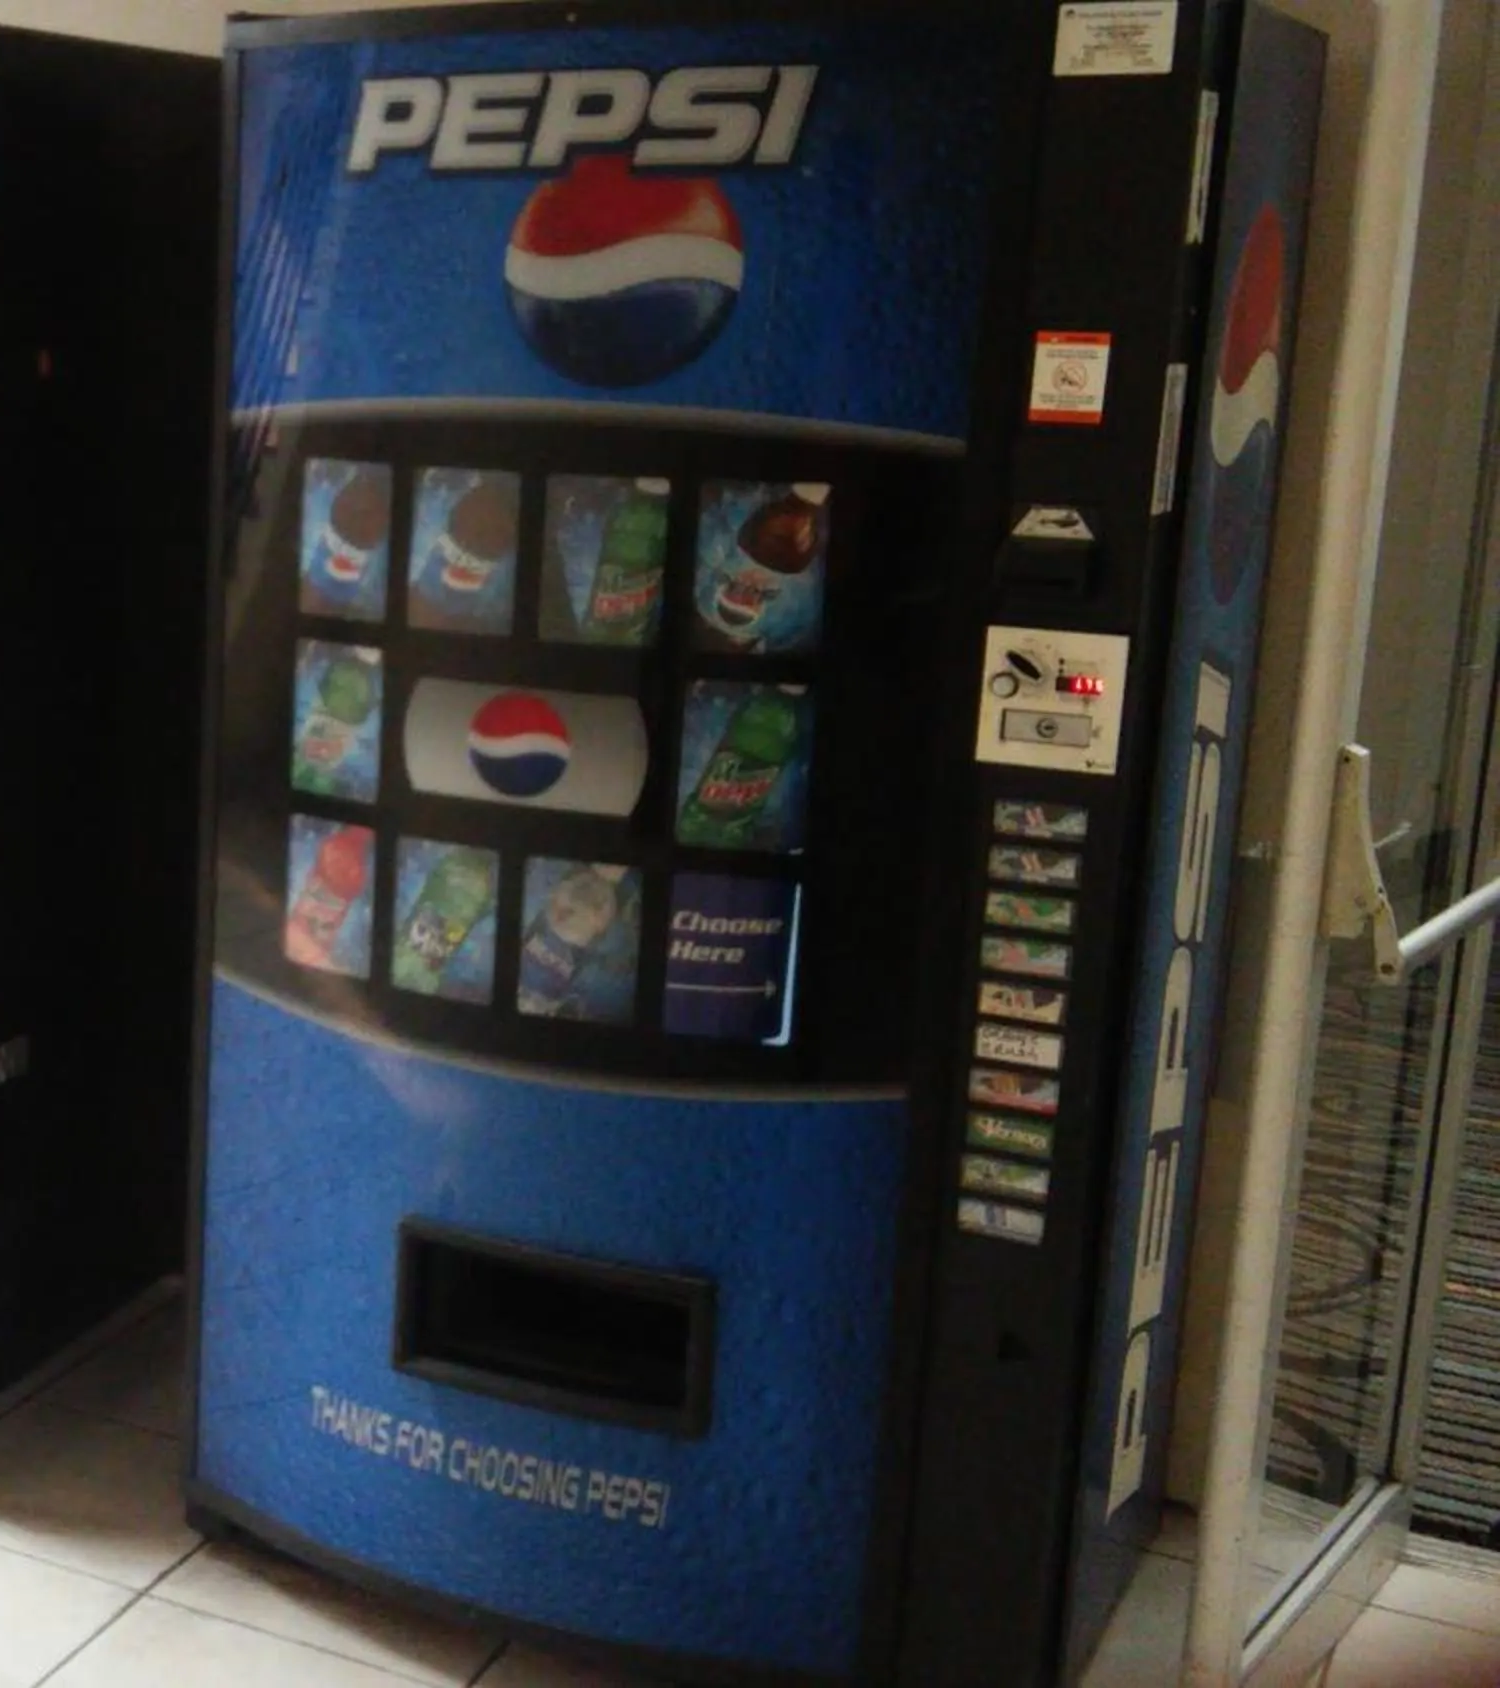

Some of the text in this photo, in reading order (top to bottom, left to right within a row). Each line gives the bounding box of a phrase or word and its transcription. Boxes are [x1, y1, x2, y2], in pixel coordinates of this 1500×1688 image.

[347, 65, 819, 171] PEPSI
[668, 939, 746, 964] Here
[671, 910, 784, 935] Choose
[1104, 661, 1231, 1524] PEPSI
[311, 1385, 671, 1529] THANKS FOR CHOOSING PEPSI
